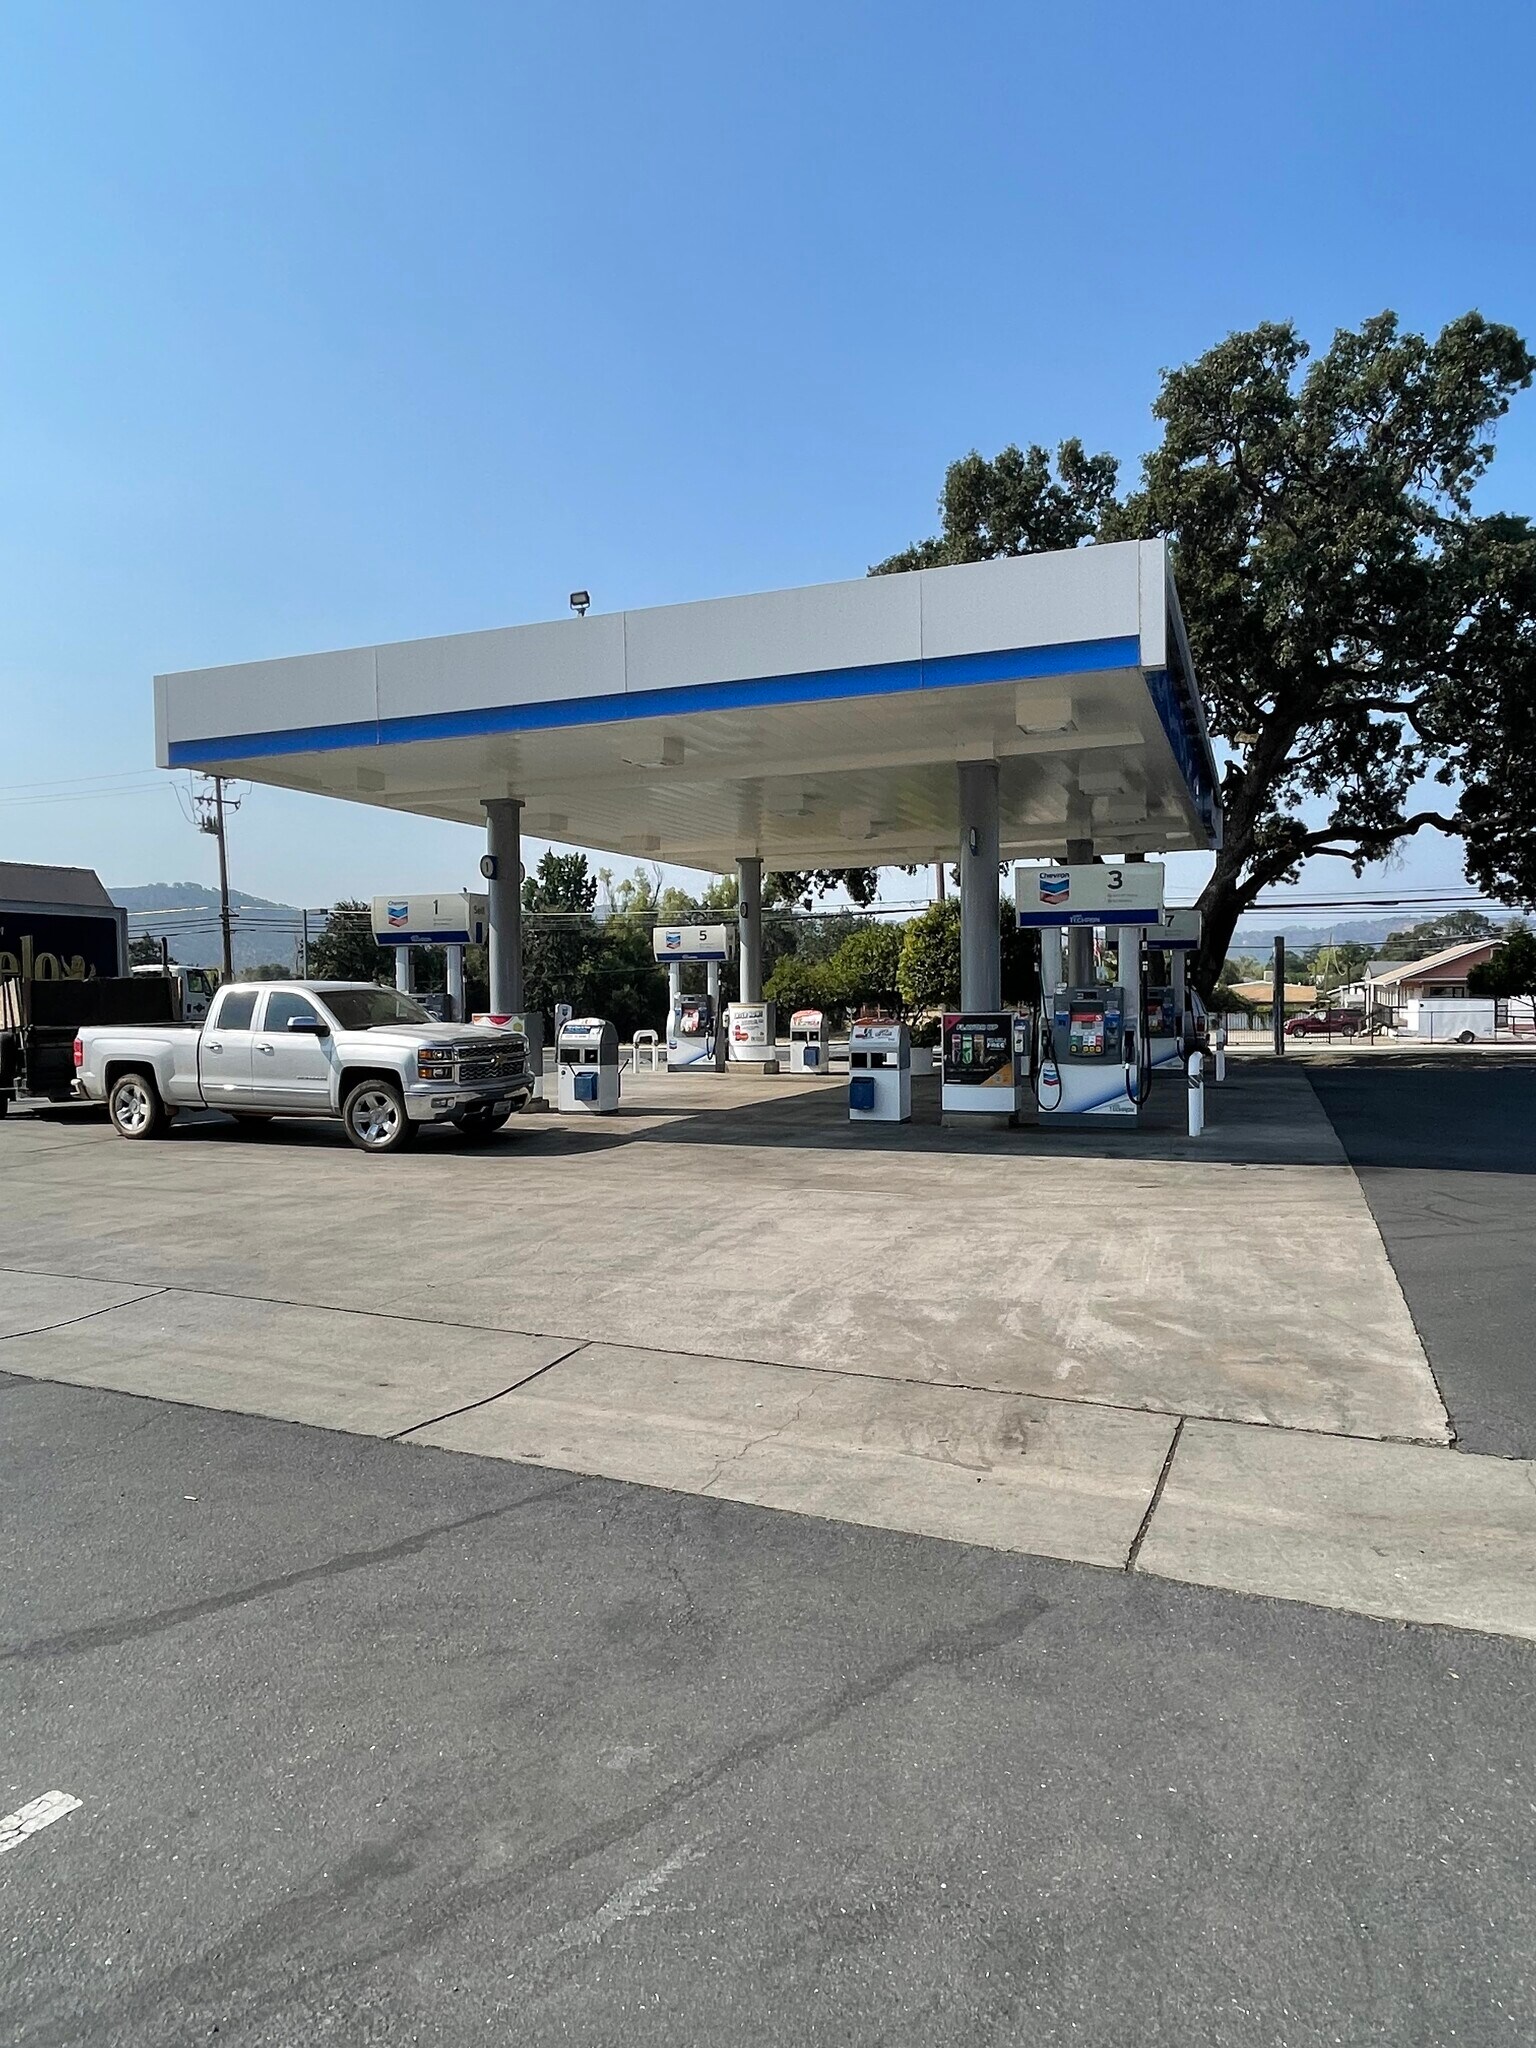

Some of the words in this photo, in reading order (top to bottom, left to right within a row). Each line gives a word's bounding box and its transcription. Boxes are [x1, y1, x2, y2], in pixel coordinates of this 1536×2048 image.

[1107, 870, 1123, 890] 3
[433, 899, 439, 915] 1
[1165, 915, 1175, 928] 7
[699, 930, 707, 941] 5
